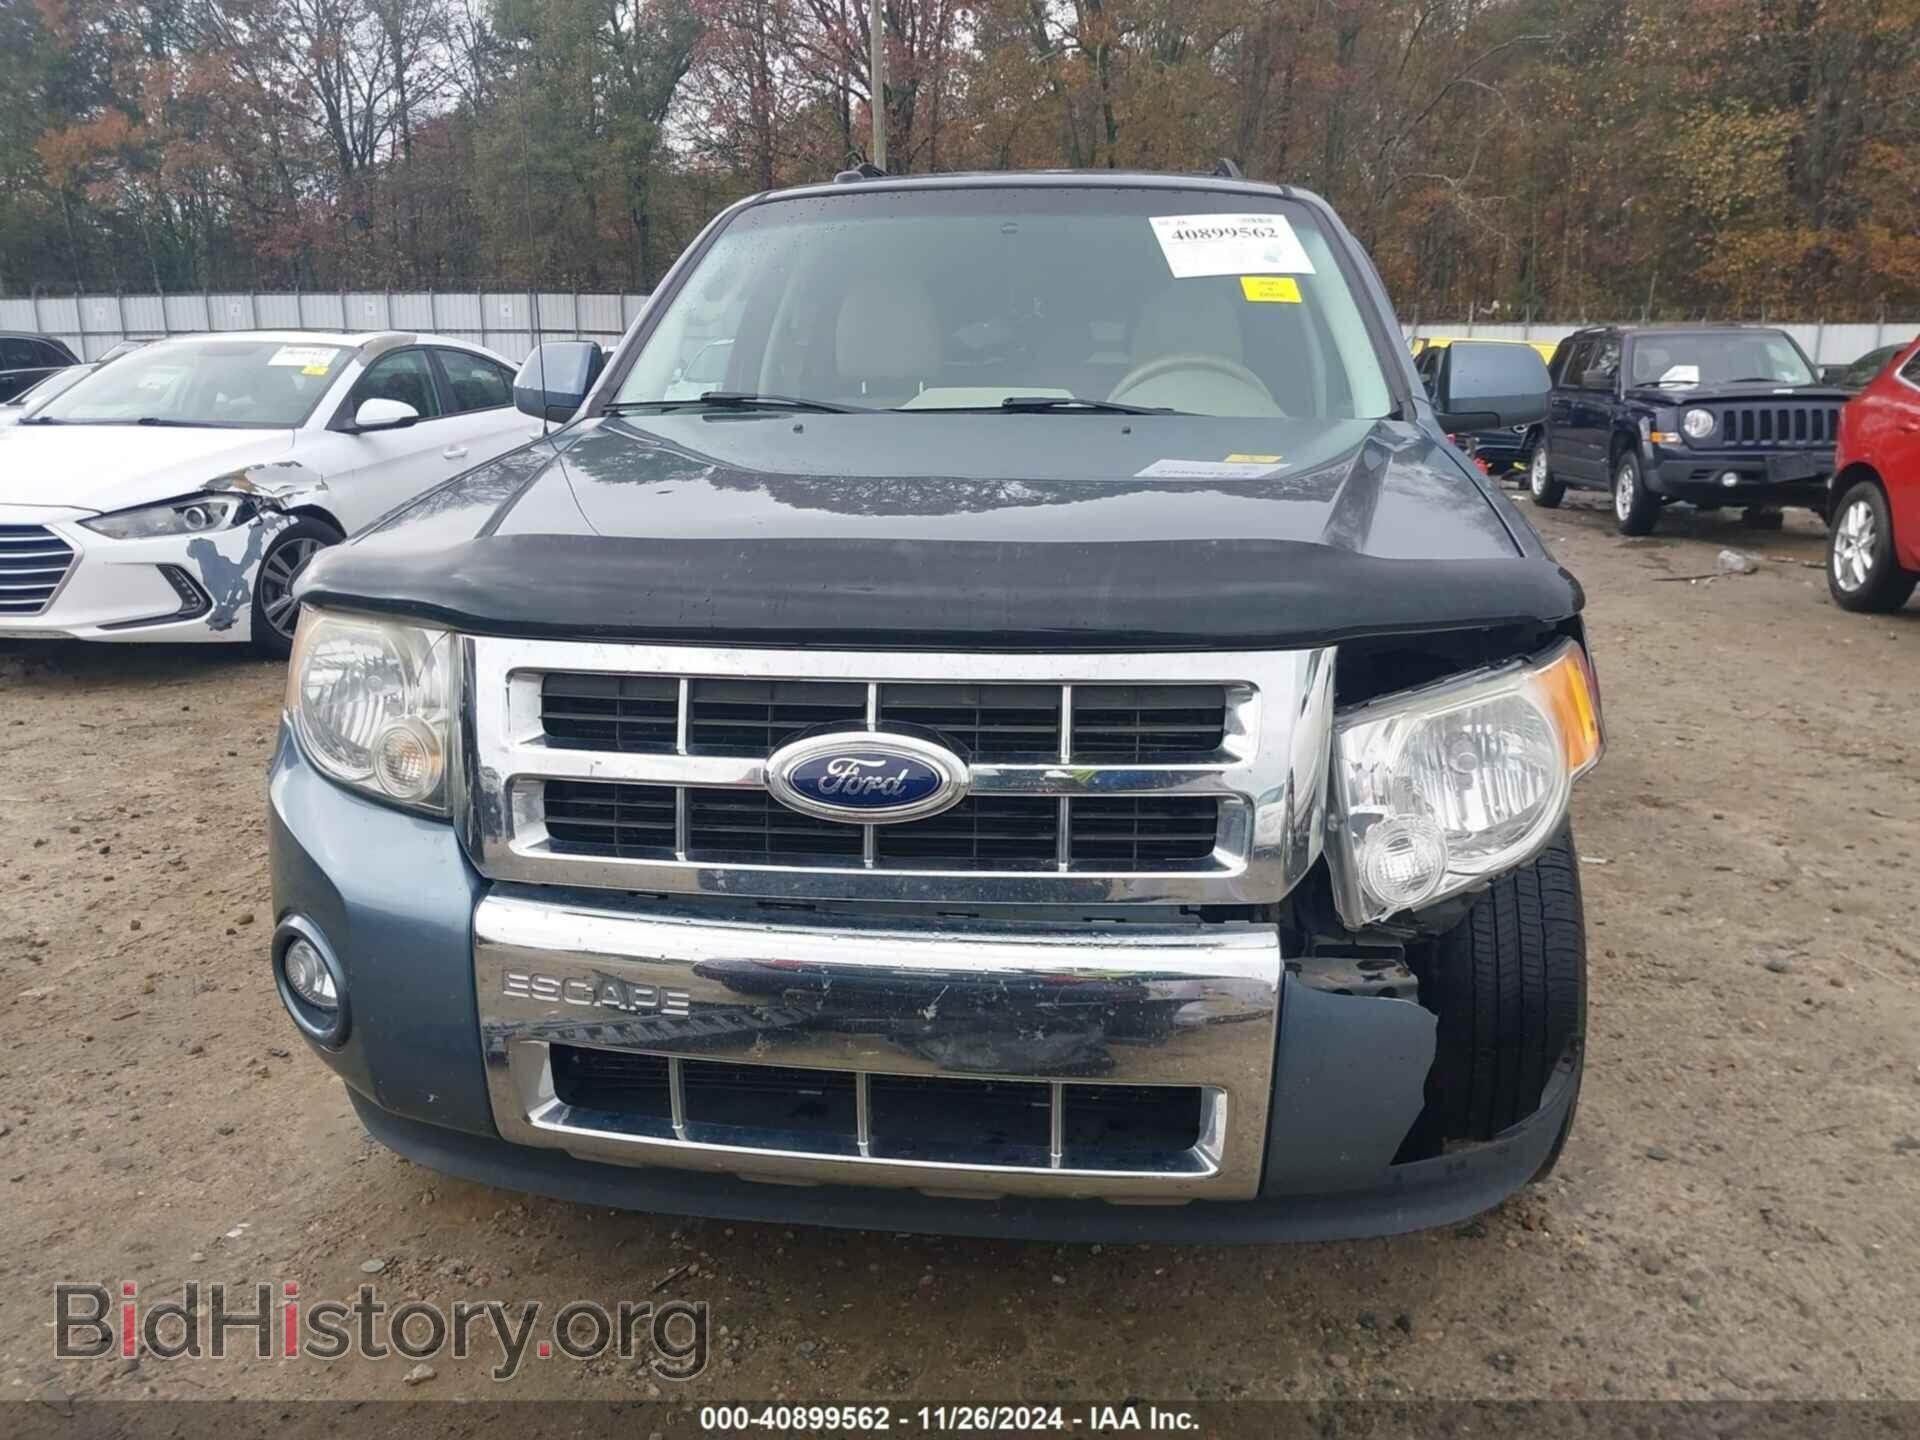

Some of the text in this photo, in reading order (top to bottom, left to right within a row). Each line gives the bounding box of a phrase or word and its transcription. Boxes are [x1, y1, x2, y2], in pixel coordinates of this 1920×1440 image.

[1170, 226, 1279, 242] 40899562
[816, 757, 908, 796] Ford
[503, 970, 689, 1016] ESCAPE
